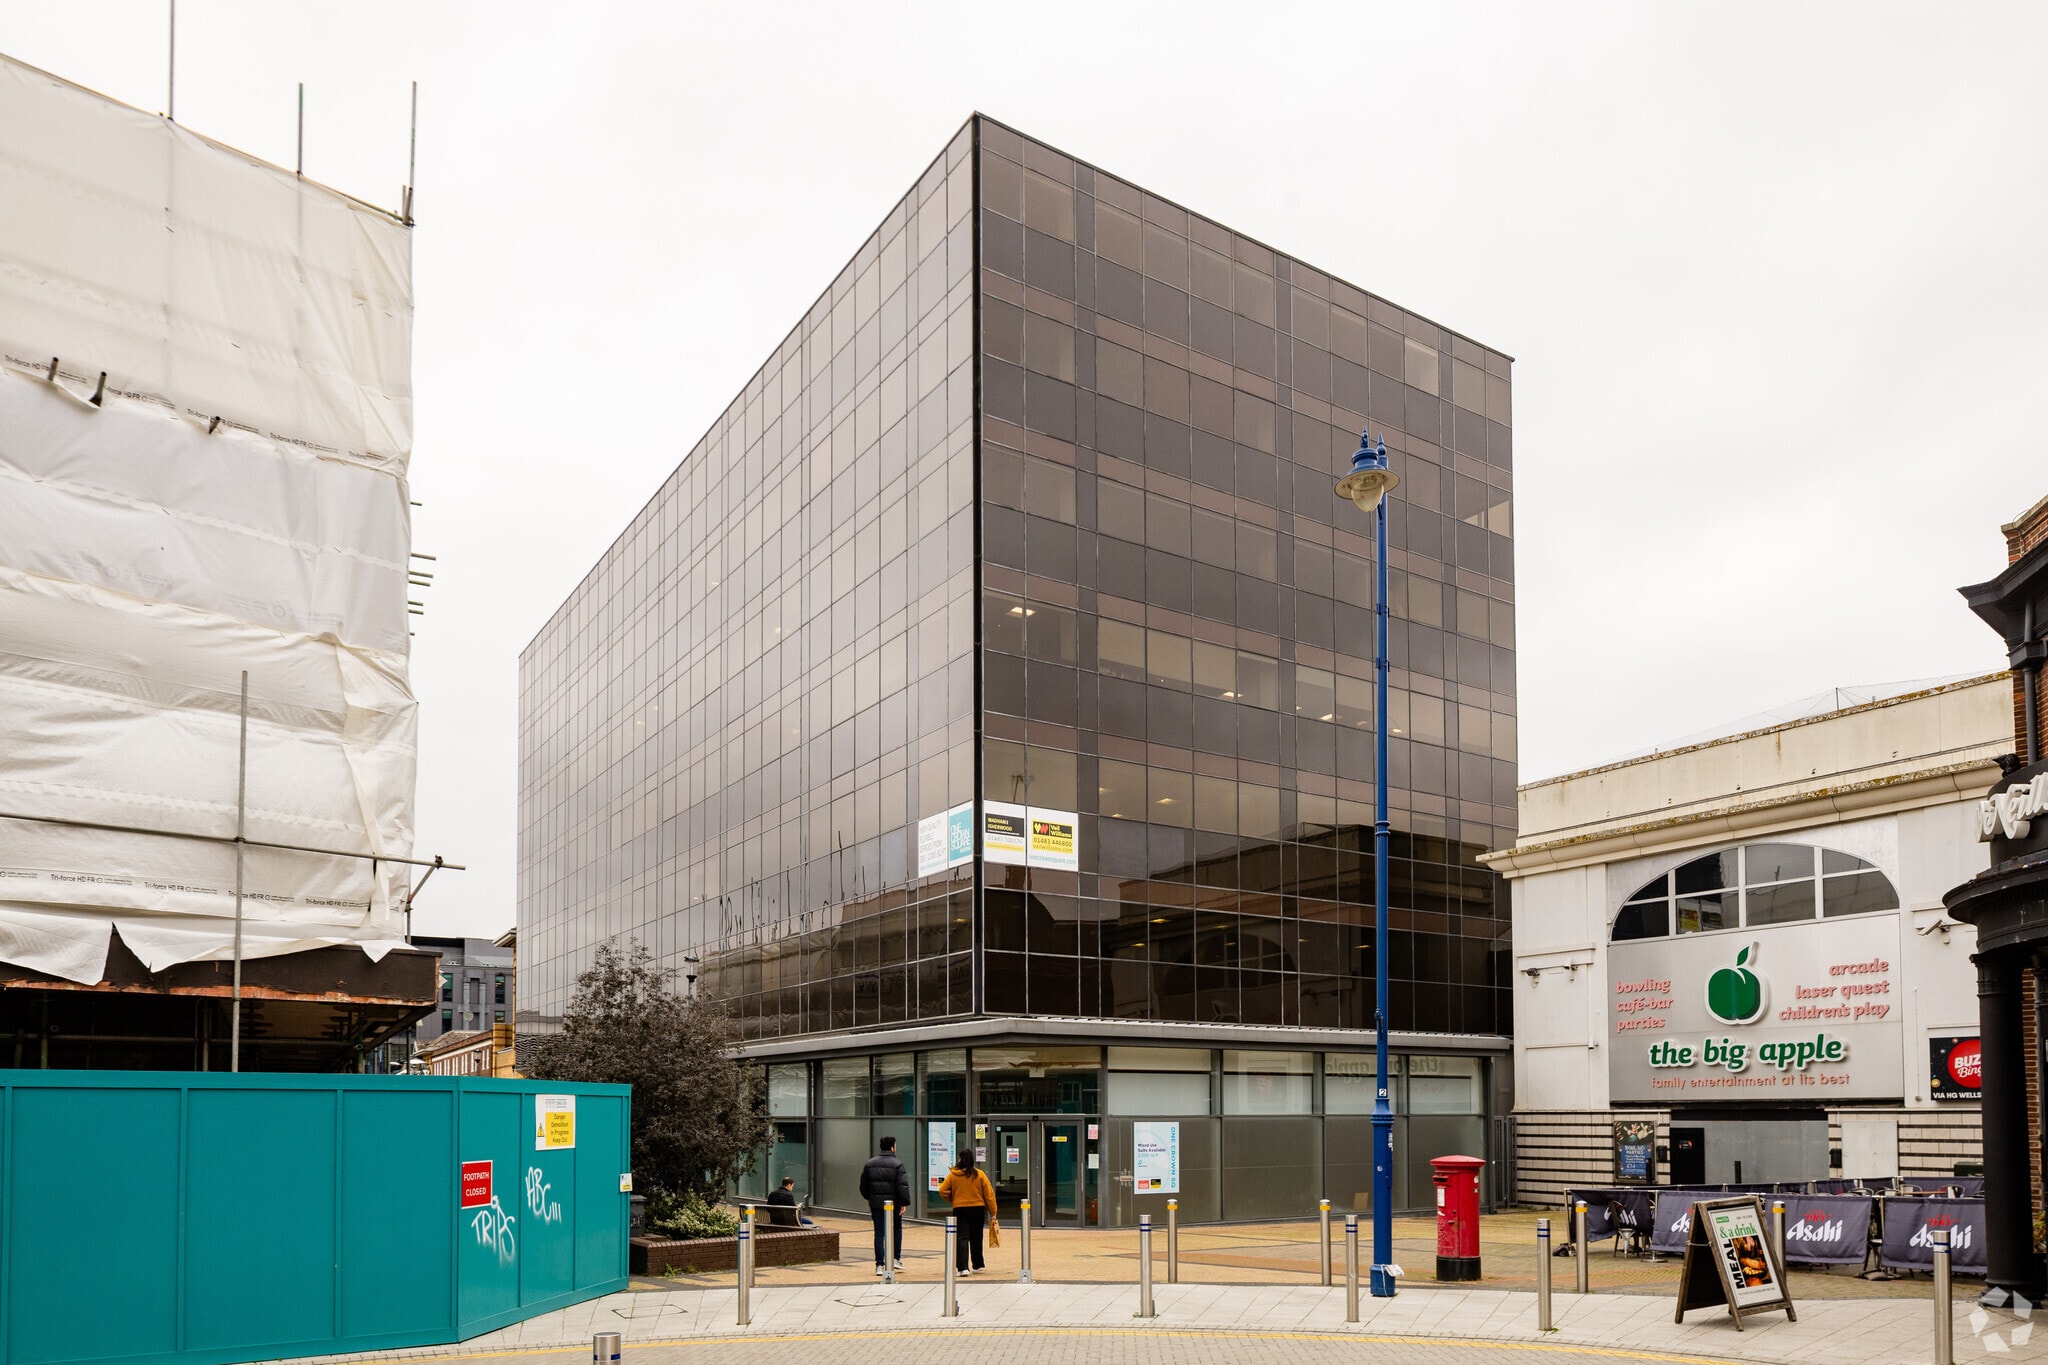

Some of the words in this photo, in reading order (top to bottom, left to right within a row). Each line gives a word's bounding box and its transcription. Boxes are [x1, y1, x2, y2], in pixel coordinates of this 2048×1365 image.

[951, 822, 962, 834] ONE
[1050, 830, 1072, 838] Williams
[951, 837, 971, 851] SQUARE
[1033, 837, 1051, 845] 01483
[1052, 839, 1072, 848] 446800
[51, 873, 76, 882] Tri-force
[77, 875, 86, 883] HD
[87, 875, 95, 884] FR
[144, 881, 167, 890] Tri-force
[249, 891, 257, 900] HD
[257, 892, 264, 901] FR
[305, 898, 325, 906] Tri-force
[1829, 958, 1889, 976] arcade
[1616, 979, 1671, 993] bowling
[1795, 985, 1837, 999] laser
[1840, 980, 1890, 1000] quest
[1616, 997, 1674, 1014] café-bar
[1779, 1004, 1851, 1021] children's
[1854, 1002, 1890, 1020] play
[1617, 1017, 1666, 1034] parties
[1649, 1041, 1693, 1065] the
[1703, 1038, 1746, 1070] big
[1758, 1033, 1842, 1069] apple
[1954, 1054, 1982, 1069] BUZ
[1651, 1077, 1686, 1090] family
[1690, 1075, 1777, 1089] entertainment
[1781, 1075, 1795, 1086] at
[1800, 1074, 1816, 1086] its
[1820, 1073, 1850, 1086] best
[1958, 1091, 1982, 1099] WELLS
[464, 1172, 489, 1181] FOOTPATH
[1171, 1178, 1176, 1188] SQ
[466, 1187, 487, 1197] CLOSED
[1719, 1227, 1728, 1238] &
[1728, 1228, 1735, 1237] a
[1734, 1222, 1757, 1237] drink
[1786, 1218, 1843, 1242] Asahi
[1909, 1223, 1972, 1249] Ashi
[1723, 1238, 1746, 1289] MEAL
